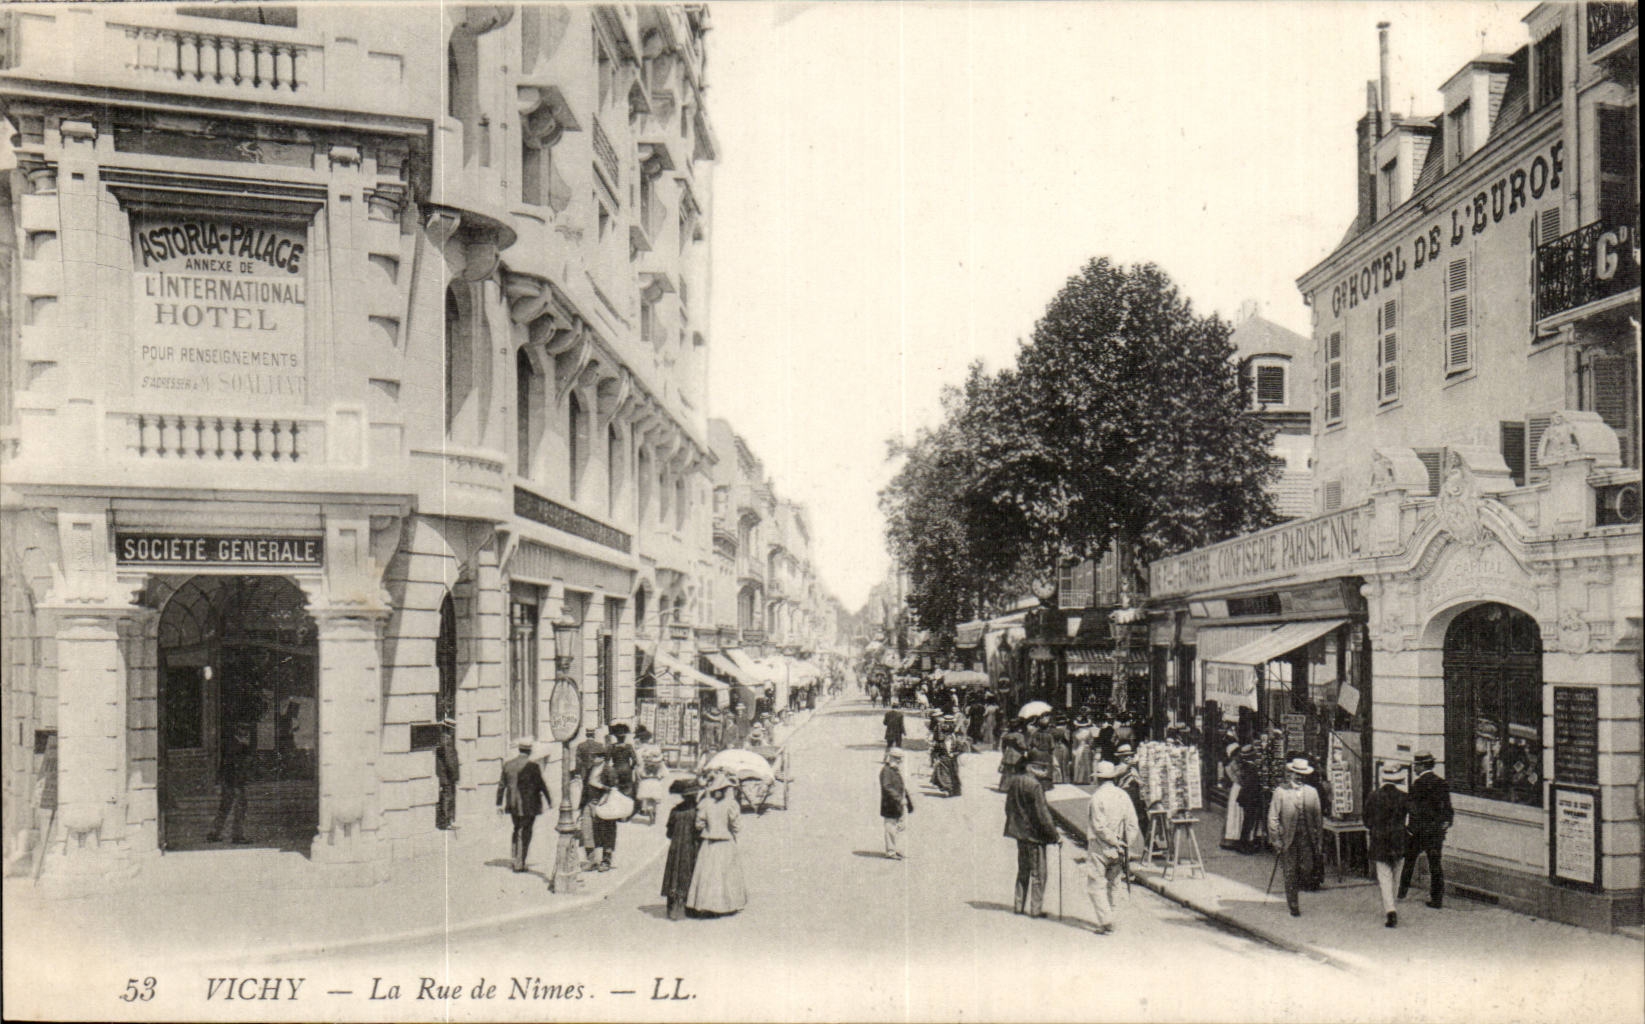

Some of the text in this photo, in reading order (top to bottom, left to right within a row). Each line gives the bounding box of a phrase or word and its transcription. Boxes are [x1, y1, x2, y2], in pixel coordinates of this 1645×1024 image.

[138, 221, 305, 274] ASTORIA-PALACE
[185, 258, 255, 274] ANNEXE DE
[1349, 246, 1406, 309] HOTEL
[1414, 225, 1441, 270] DE
[145, 272, 305, 305] L'INTERNATIONAL
[154, 303, 278, 331] HOTEL
[142, 345, 298, 367] POUR RENSEIGNEMENTS
[124, 537, 316, 562] SOCIÉTÉ GÉNÉRALE
[1217, 535, 1277, 580] CONFISERIE
[1281, 511, 1361, 567] PARISIENNE
